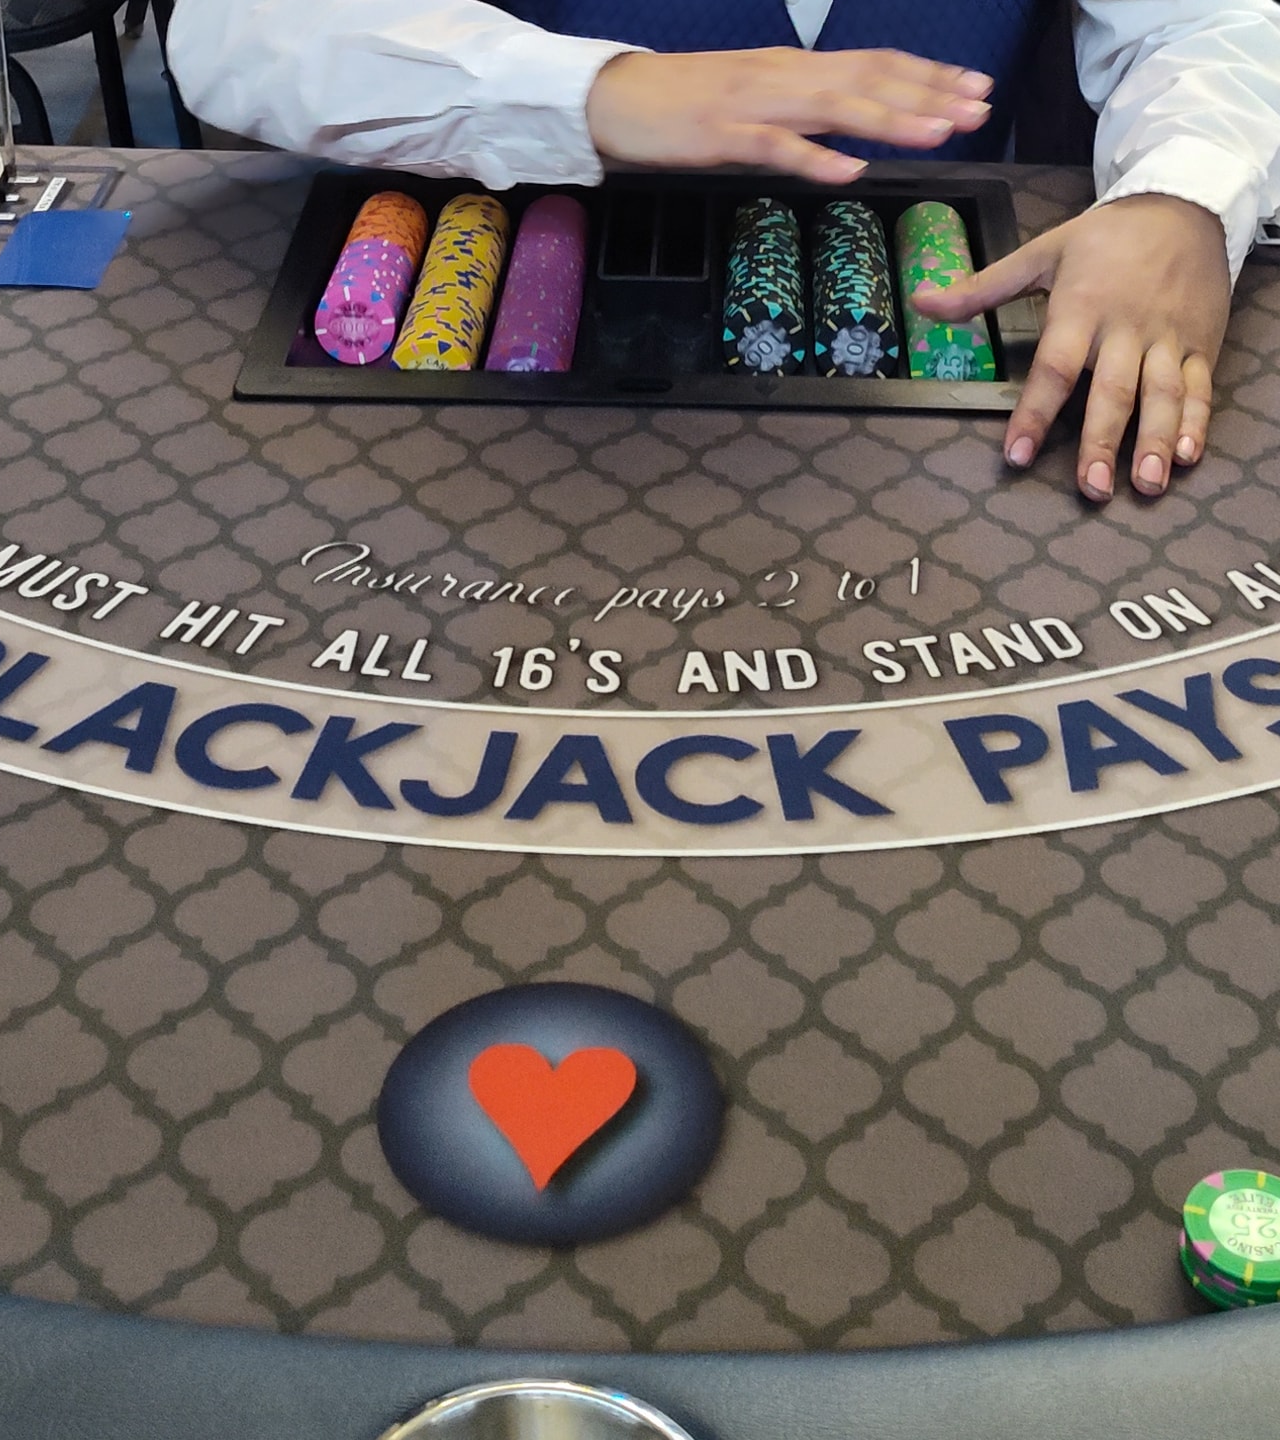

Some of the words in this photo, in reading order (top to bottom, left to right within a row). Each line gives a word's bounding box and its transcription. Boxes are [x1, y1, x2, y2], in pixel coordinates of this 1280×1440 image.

[301, 541, 581, 606] Insurance
[593, 587, 726, 623] pays
[757, 570, 800, 607] 2
[837, 571, 876, 601] to
[910, 556, 920, 595] 1
[160, 600, 285, 656] HIT
[313, 629, 433, 683] ALL
[490, 637, 623, 694] 16'S
[677, 647, 819, 693] AND
[862, 616, 1084, 684] STAND
[1108, 587, 1214, 641] ON
[1230, 1213, 1278, 1239] 25
